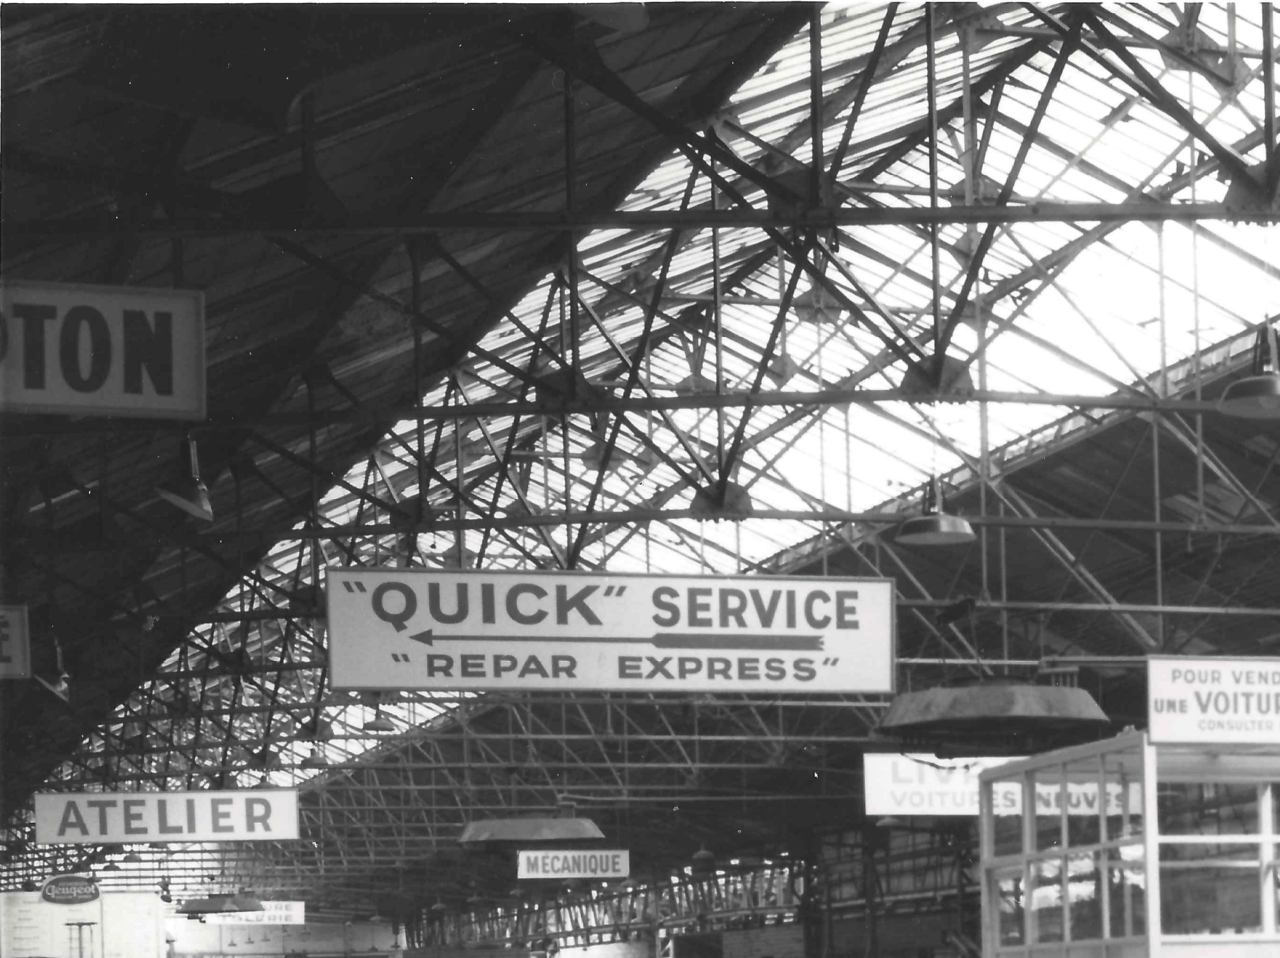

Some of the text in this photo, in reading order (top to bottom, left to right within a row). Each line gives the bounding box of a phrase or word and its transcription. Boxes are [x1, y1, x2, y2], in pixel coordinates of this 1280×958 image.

[0, 303, 173, 396] TON
[342, 581, 859, 633] "QUICK" SERVICE
[618, 656, 839, 681] EXPRESS"
[1171, 669, 1222, 685] POUR
[1154, 699, 1188, 714] UNE
[1198, 719, 1274, 732] CONSULTER
[58, 797, 272, 836] ATELIER
